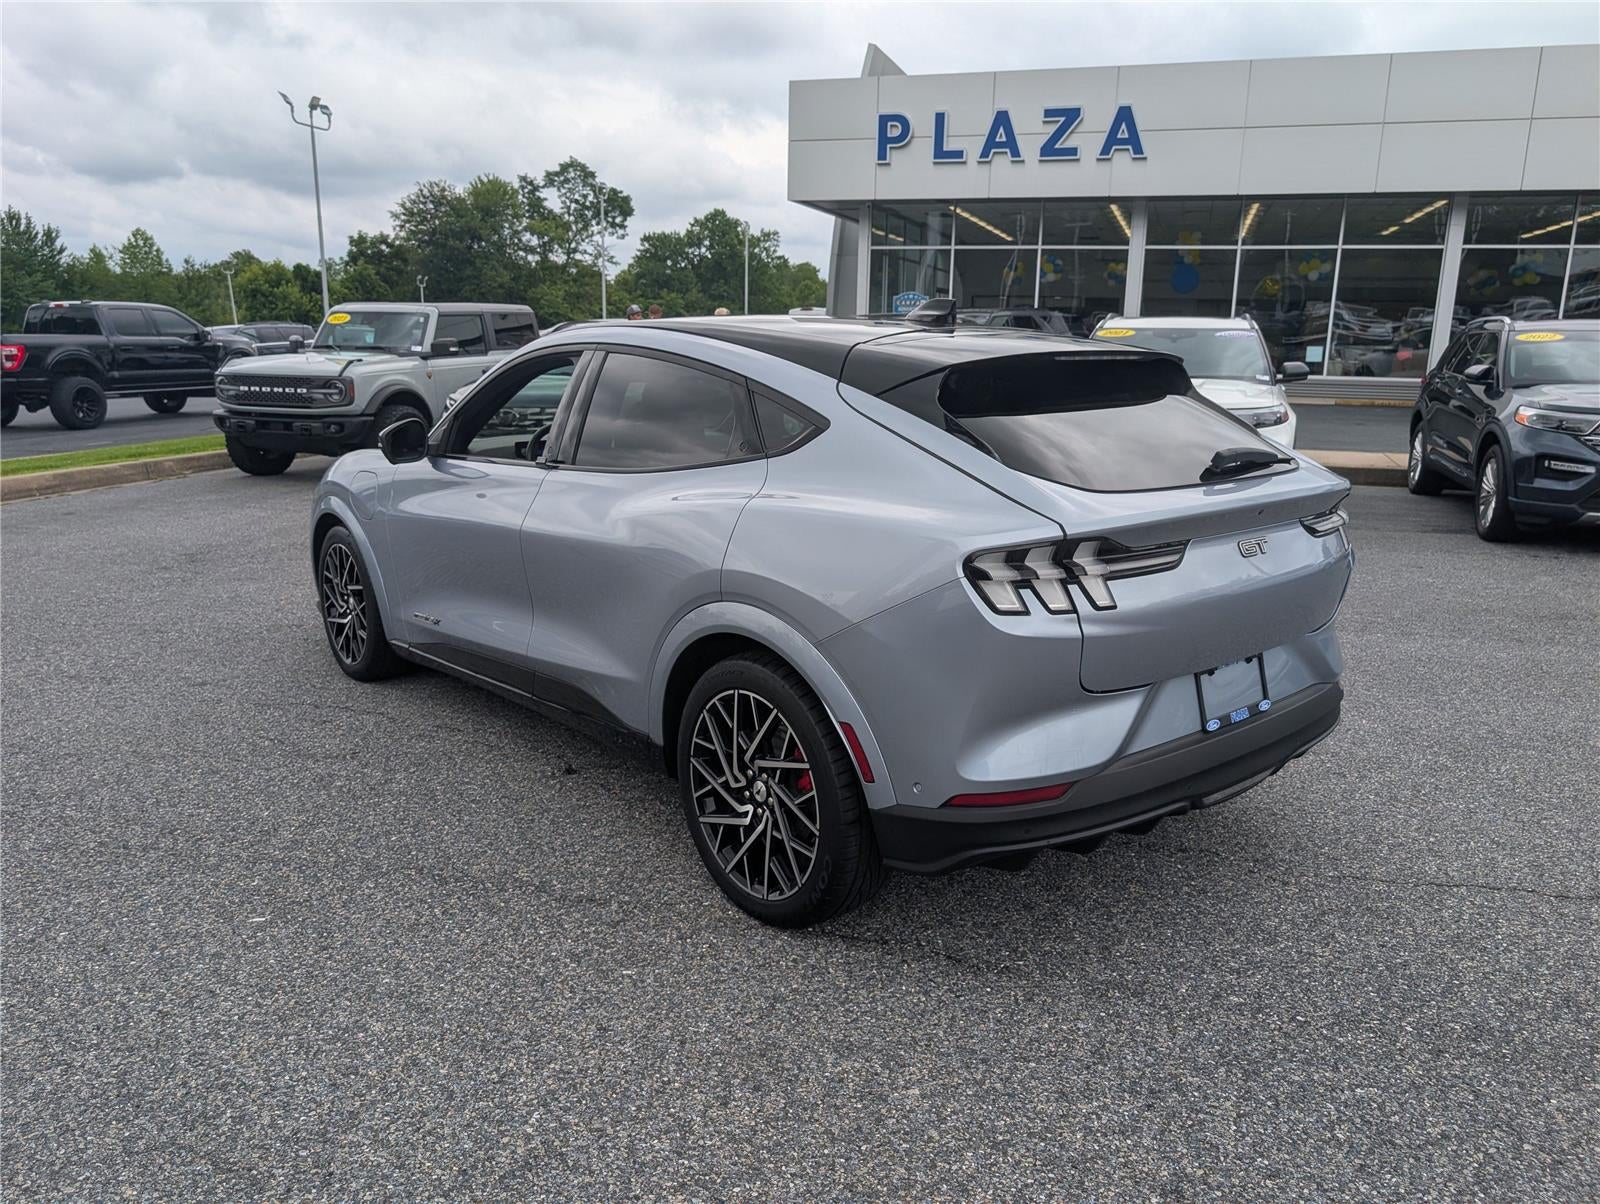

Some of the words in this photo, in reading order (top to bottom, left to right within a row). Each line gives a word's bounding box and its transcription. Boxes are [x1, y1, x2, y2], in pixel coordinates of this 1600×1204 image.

[876, 104, 1147, 164] PLAZA
[239, 385, 307, 394] BRONCO
[1238, 536, 1267, 558] GT
